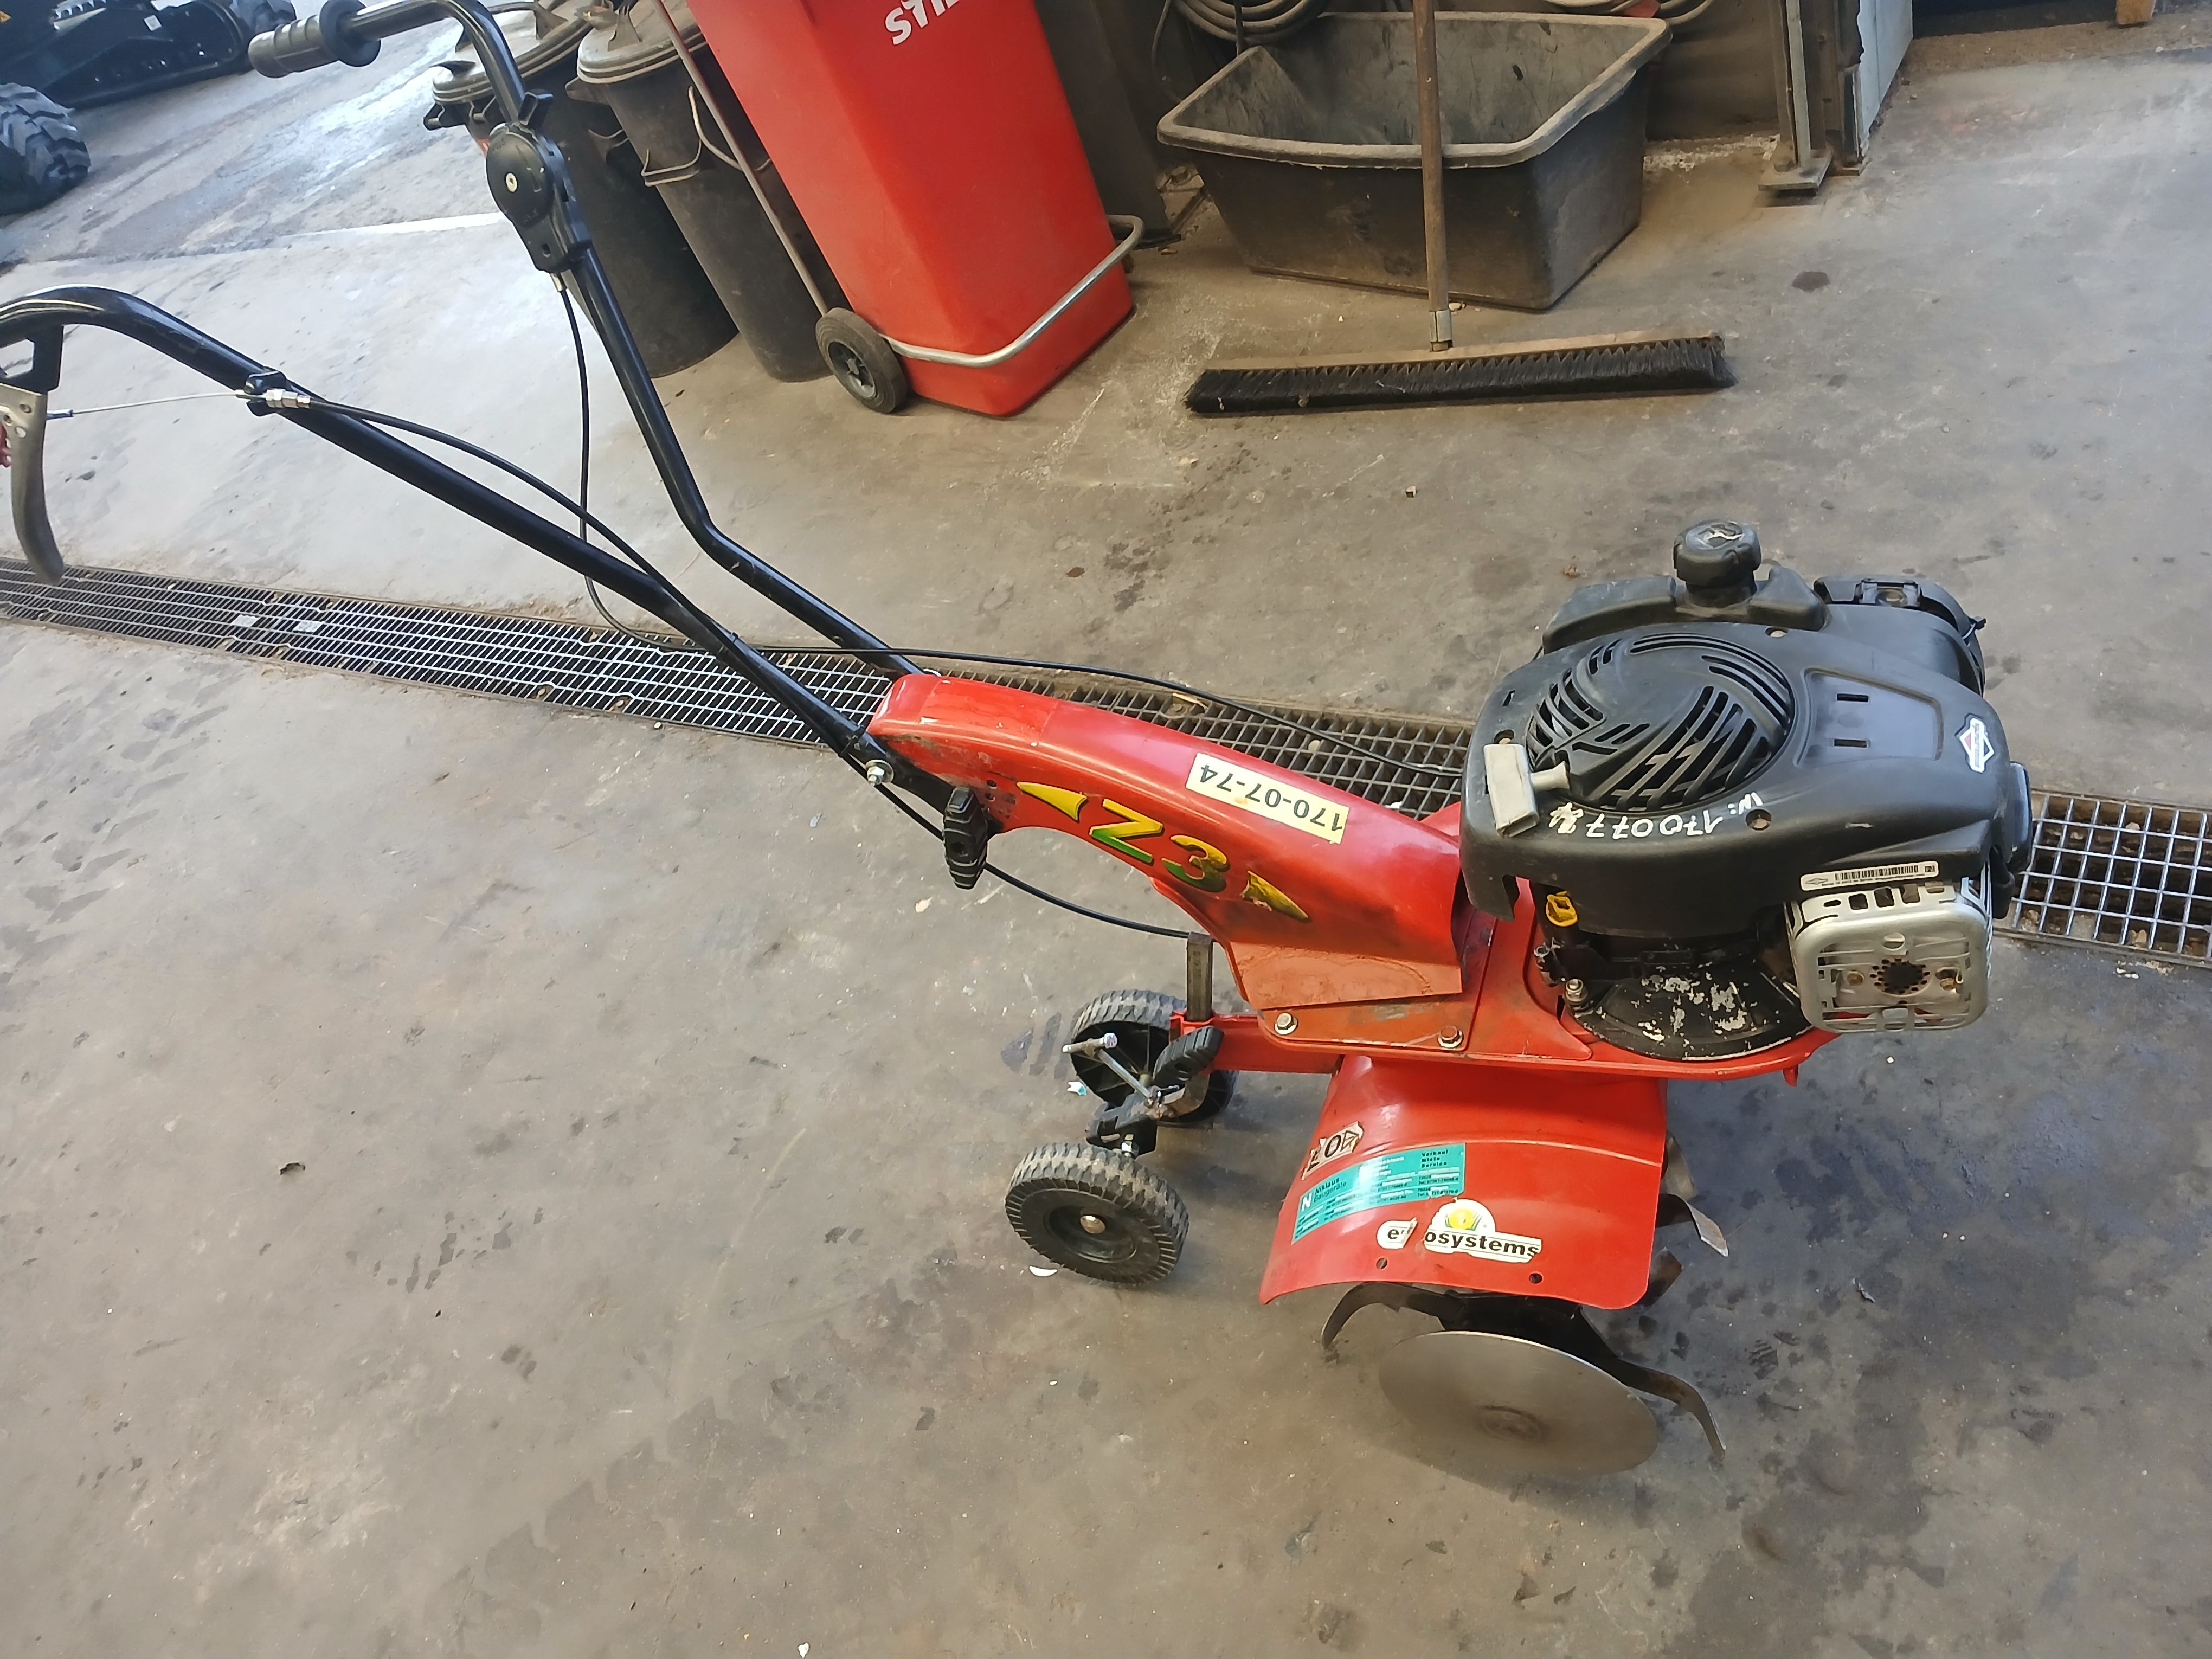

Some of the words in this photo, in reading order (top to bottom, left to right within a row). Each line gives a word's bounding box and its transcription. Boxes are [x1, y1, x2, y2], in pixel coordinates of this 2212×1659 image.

[1200, 764, 1343, 832] 170-07-74
[1089, 798, 1231, 893] Z3
[1315, 1177, 1340, 1194] Niklaus
